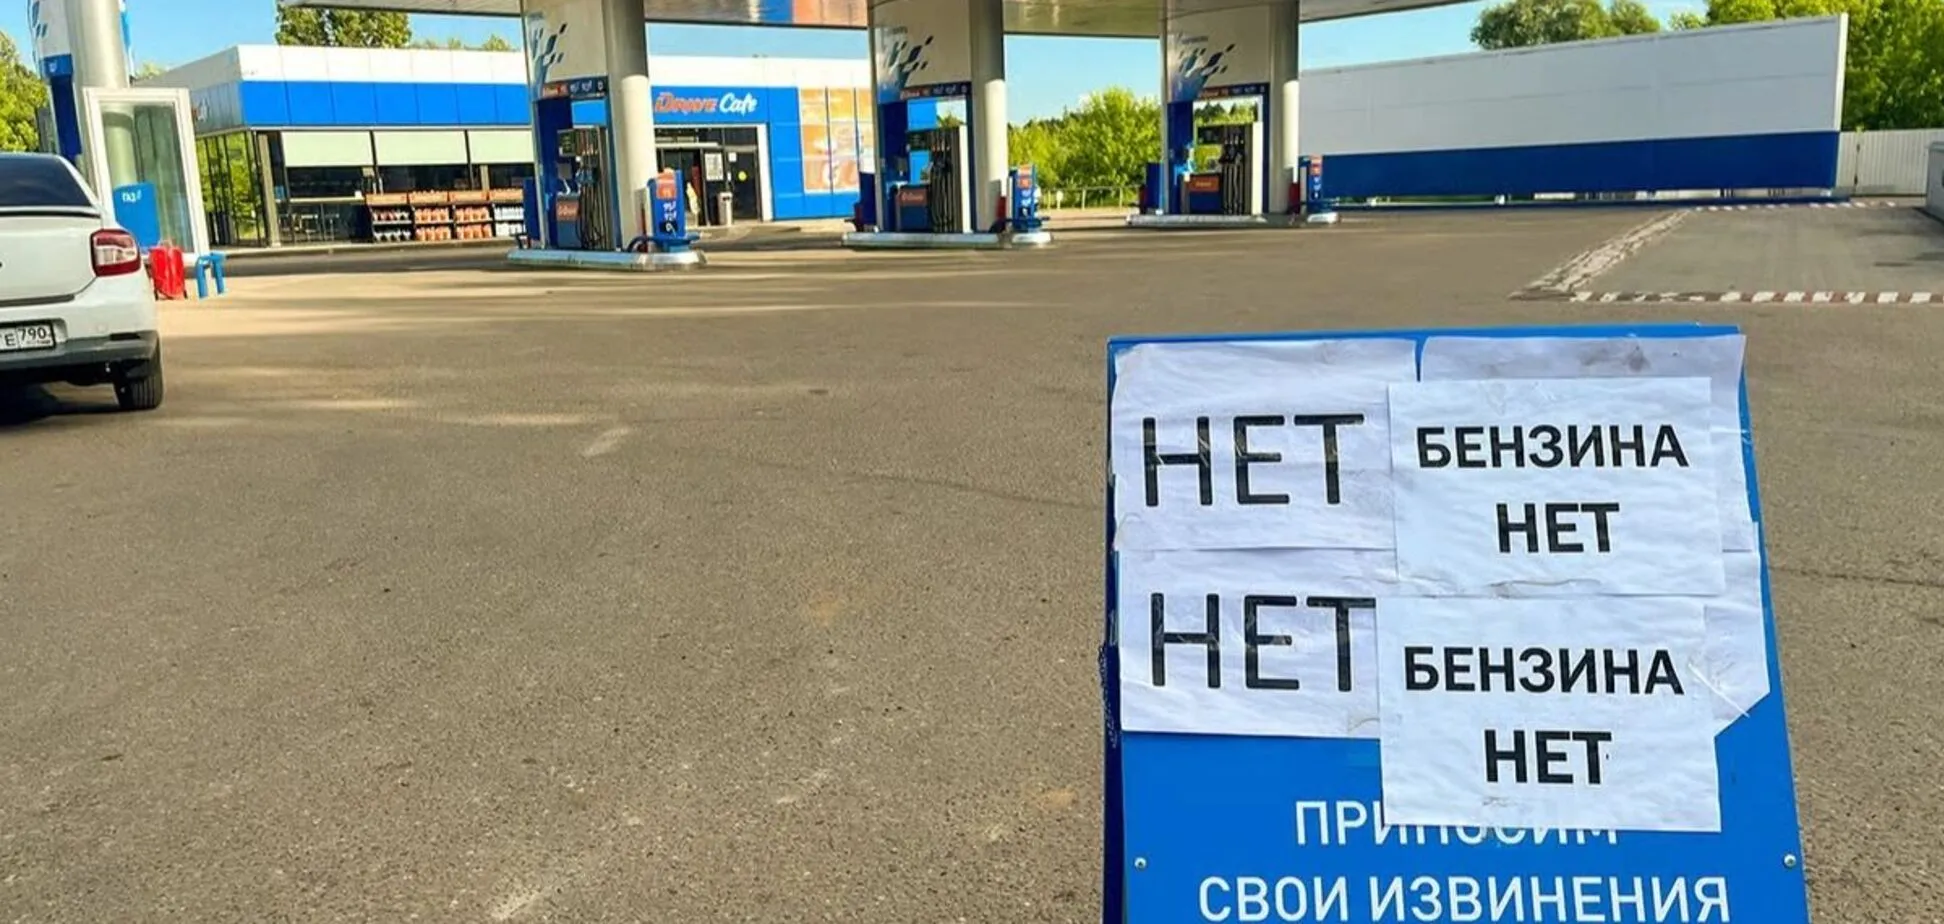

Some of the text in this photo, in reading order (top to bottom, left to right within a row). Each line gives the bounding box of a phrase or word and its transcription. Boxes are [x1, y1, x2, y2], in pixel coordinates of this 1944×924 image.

[17, 326, 47, 341] 790
[1143, 414, 1364, 507] НЕТ
[1416, 424, 1689, 468] БЕНЗИНА
[1496, 503, 1620, 553] НЕТ
[1151, 593, 1376, 691] НЕТ
[1404, 646, 1684, 695] БЕНЗИНА
[1484, 729, 1612, 785] НЕТ
[1200, 876, 1730, 923] СВОИ ИЗВИНЕНИЯ
